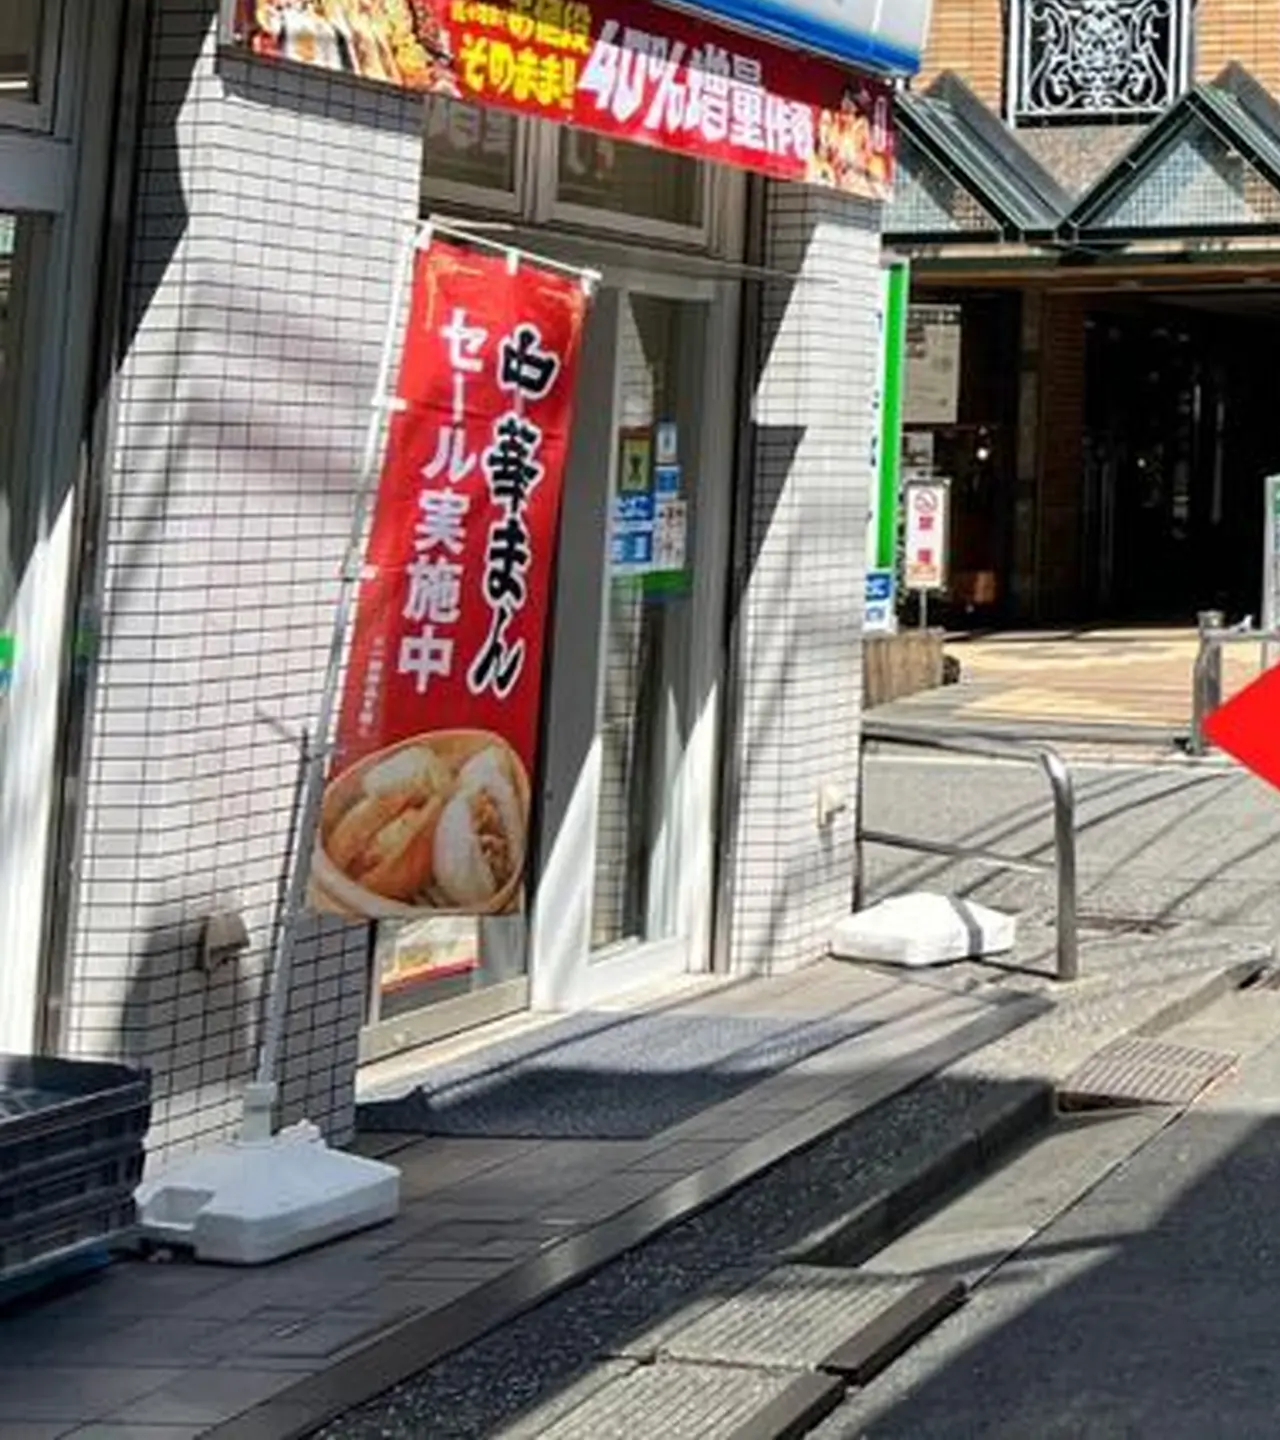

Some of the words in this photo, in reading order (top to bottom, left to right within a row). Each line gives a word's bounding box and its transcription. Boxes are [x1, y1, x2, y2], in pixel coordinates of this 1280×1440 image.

[398, 307, 486, 694] セール実施中
[466, 322, 560, 698] 中華まん
